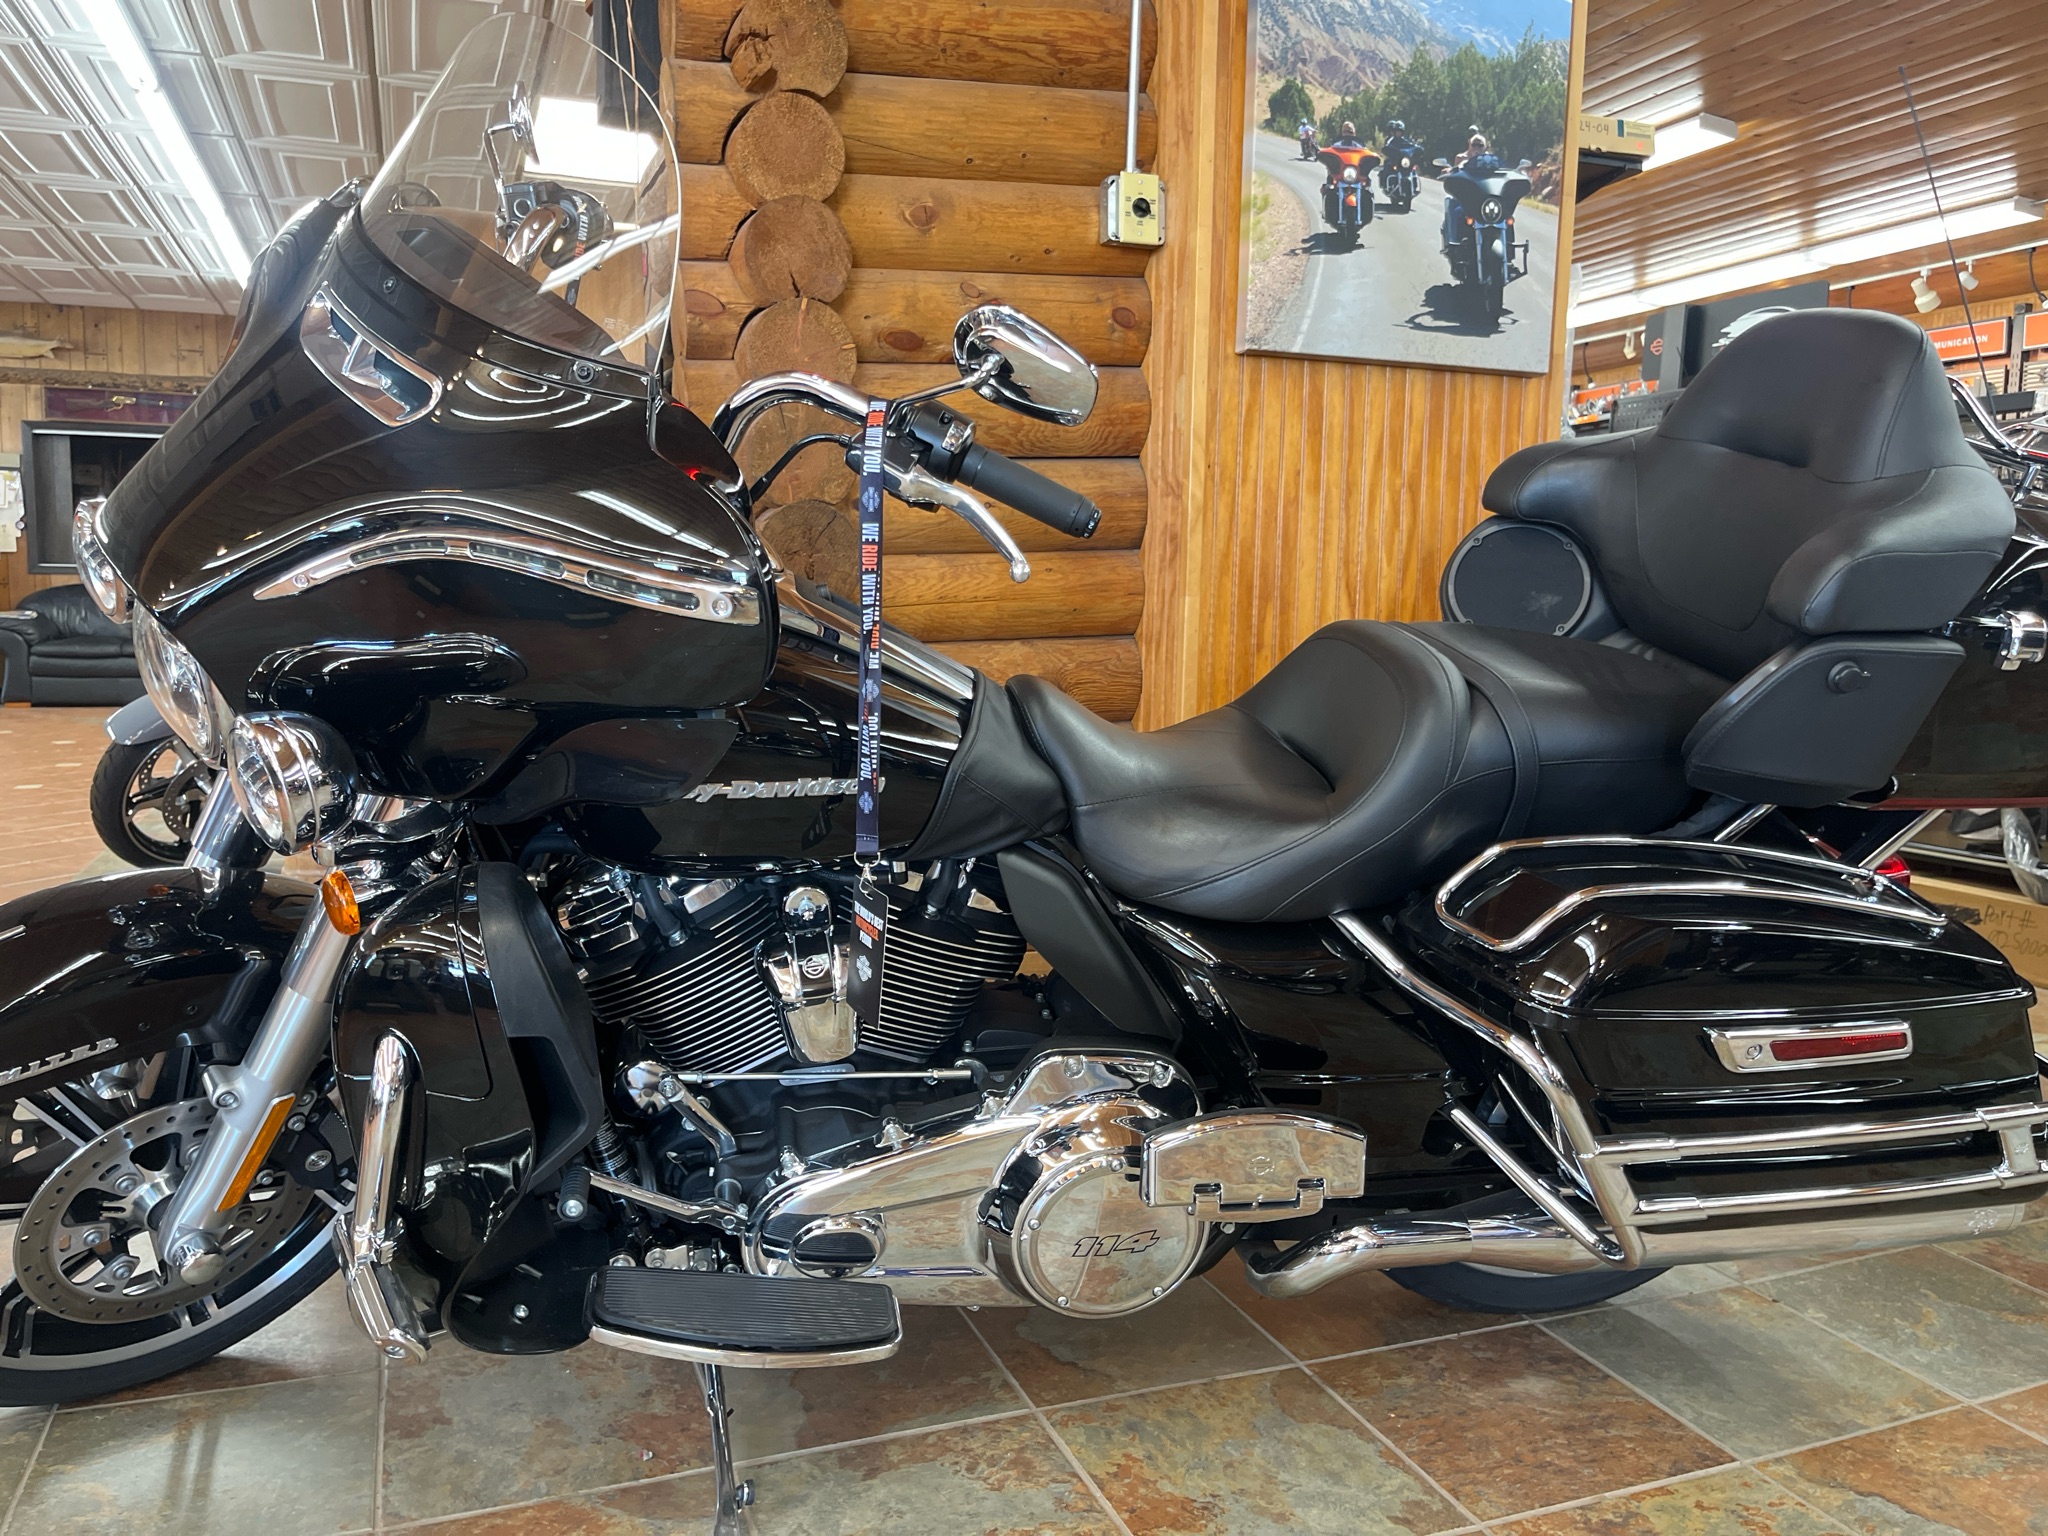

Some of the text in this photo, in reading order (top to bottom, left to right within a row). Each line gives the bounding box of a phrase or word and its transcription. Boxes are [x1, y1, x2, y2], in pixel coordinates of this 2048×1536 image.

[864, 427, 884, 448] WITH
[863, 449, 882, 477] YOU.
[861, 523, 879, 542] WE
[861, 544, 879, 572] RIDE
[862, 574, 877, 605] WITH
[862, 606, 875, 635] YOU.
[860, 725, 871, 756] WITH
[859, 757, 872, 781] YOU.
[1983, 904, 2039, 931] Part #
[1071, 1229, 1161, 1258] 114
